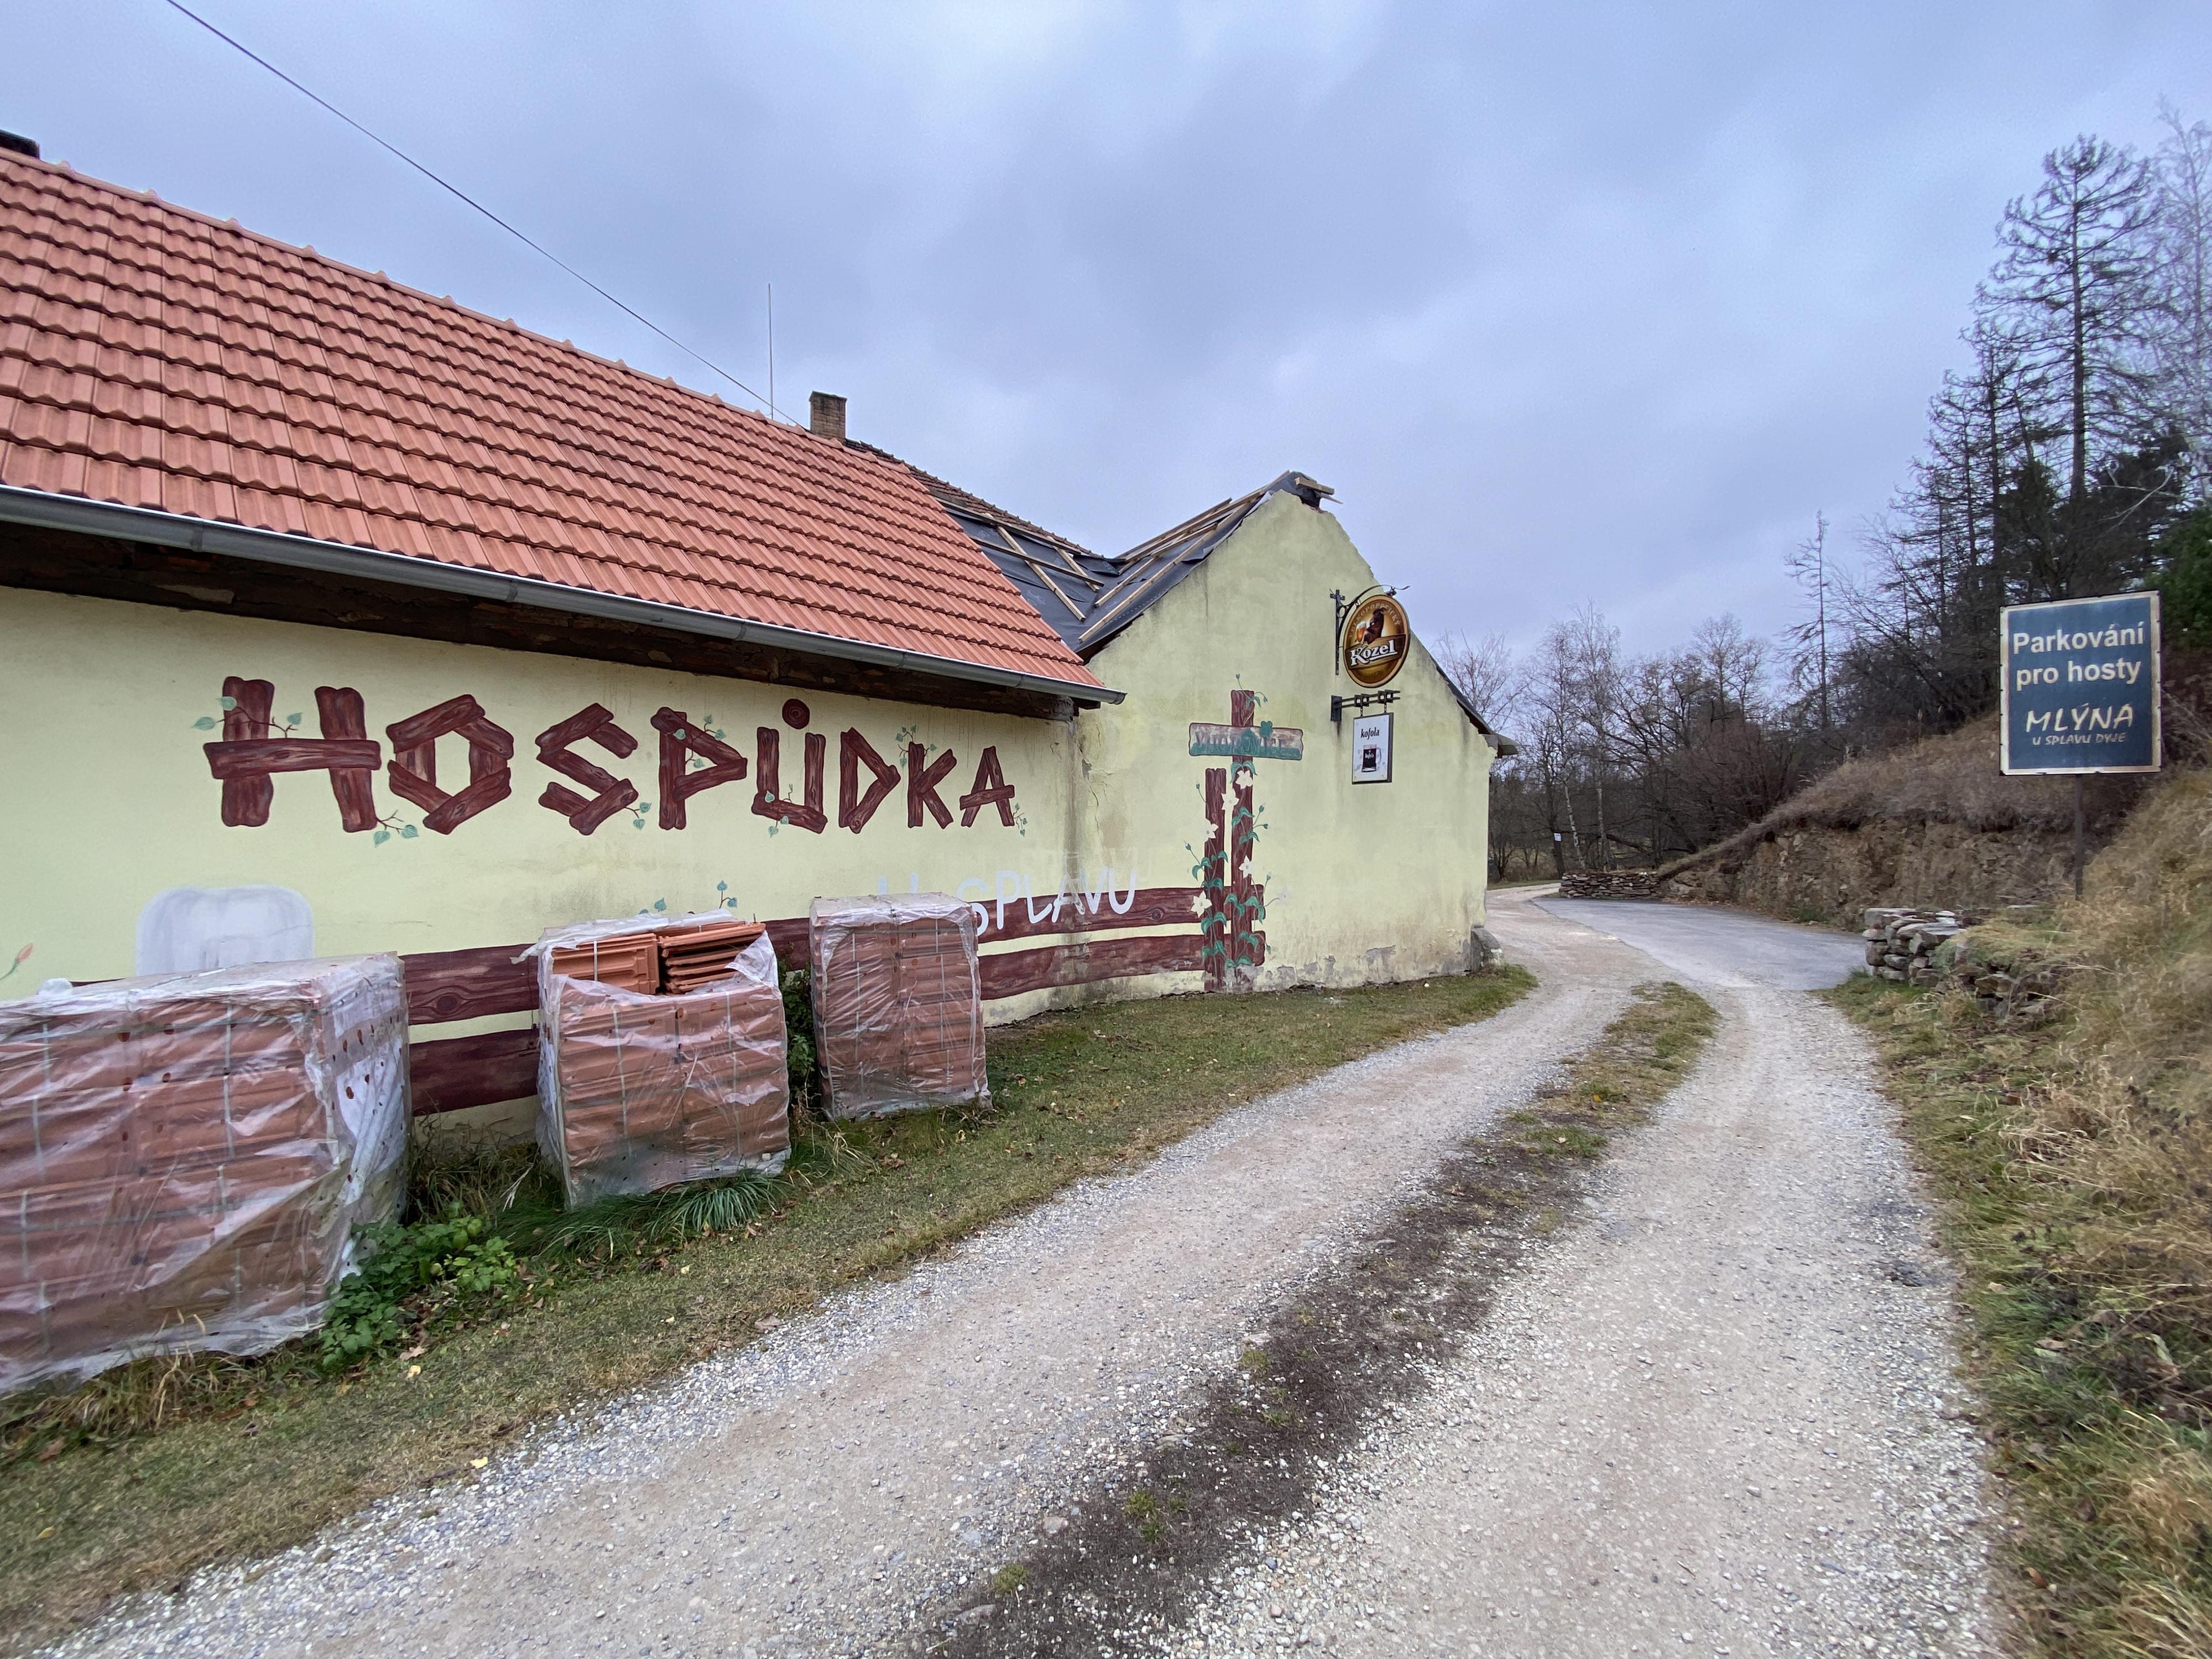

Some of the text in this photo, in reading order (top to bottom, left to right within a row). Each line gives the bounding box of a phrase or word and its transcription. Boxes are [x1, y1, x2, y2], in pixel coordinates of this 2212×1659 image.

[1350, 639, 1397, 666] Kozel
[2013, 621, 2145, 655] Parkování
[2016, 658, 2142, 691] pro hosty
[1360, 727, 1380, 740] kofola
[2026, 703, 2134, 733] MLÝNA
[2032, 732, 2126, 745] U SPLAVU DYJE
[202, 676, 1015, 834] HOSPŮDKA
[956, 865, 1138, 936] SPLAVU
